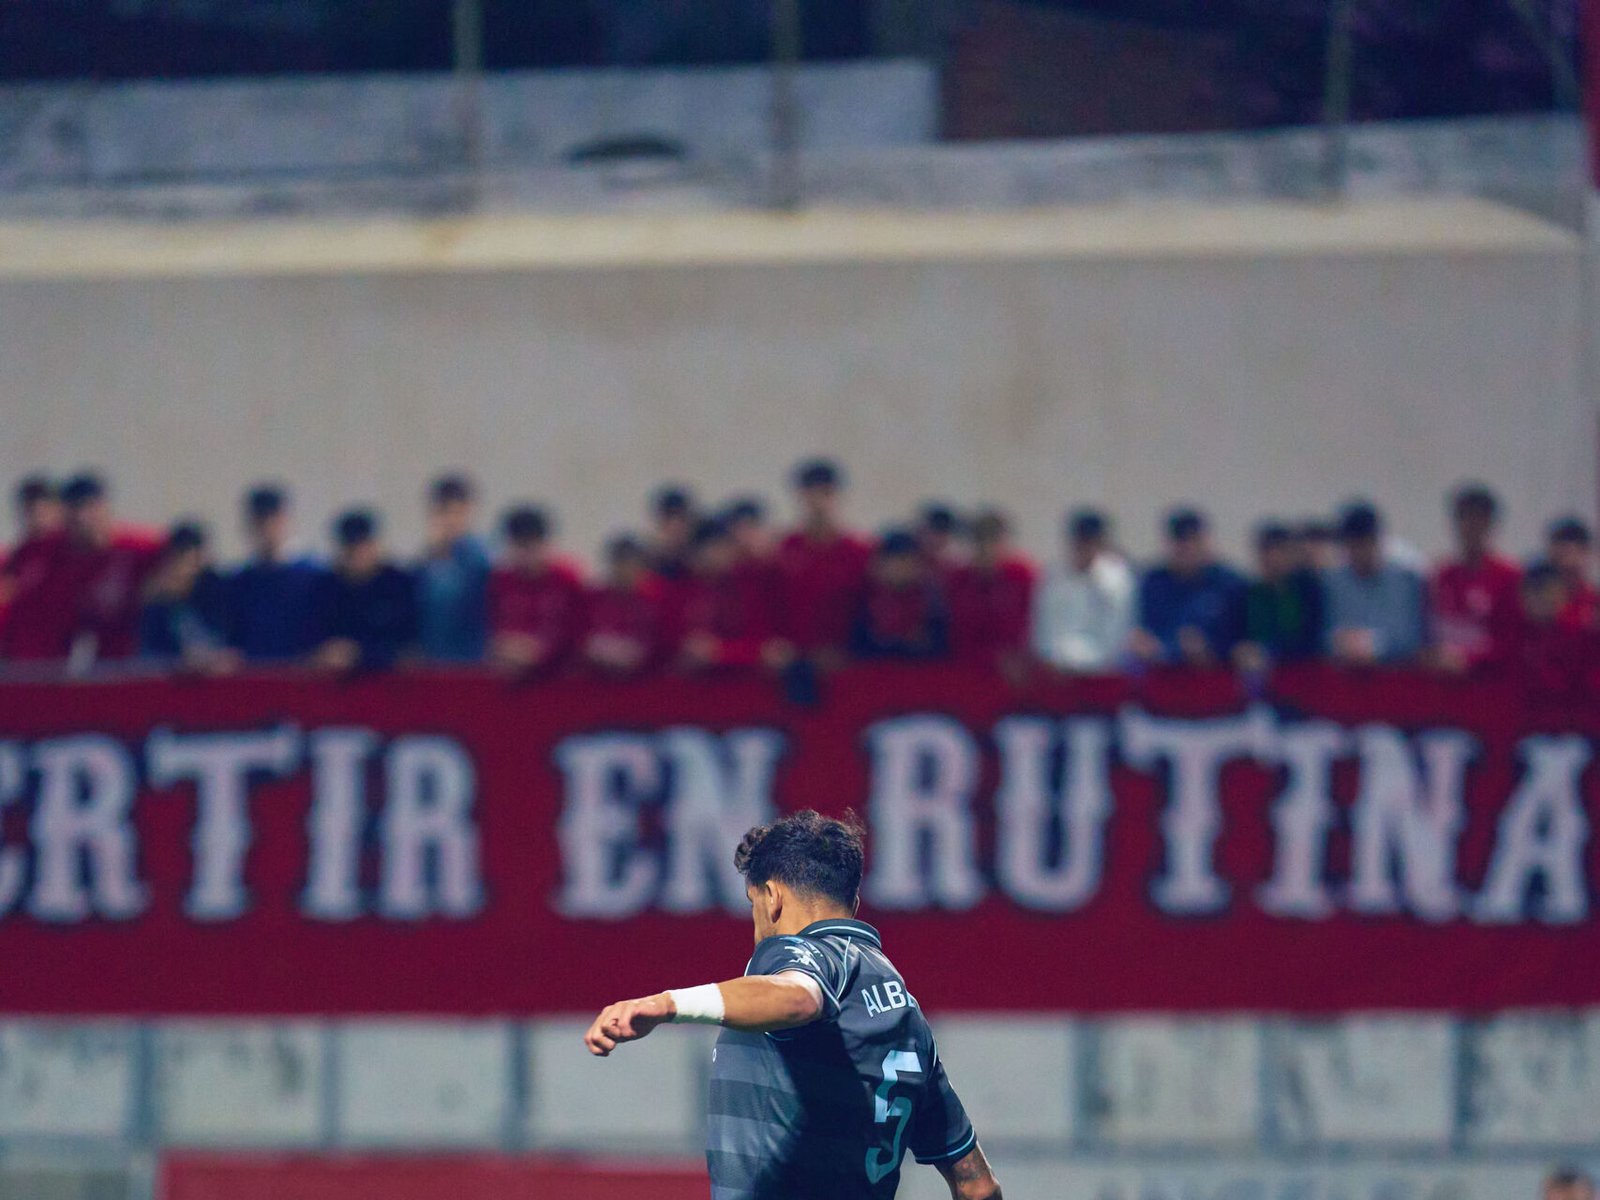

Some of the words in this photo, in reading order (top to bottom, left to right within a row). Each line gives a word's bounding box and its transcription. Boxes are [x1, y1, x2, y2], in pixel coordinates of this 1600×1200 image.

[0, 718, 488, 922] RTIR
[553, 724, 787, 920] EN
[863, 702, 1595, 924] RUTINA
